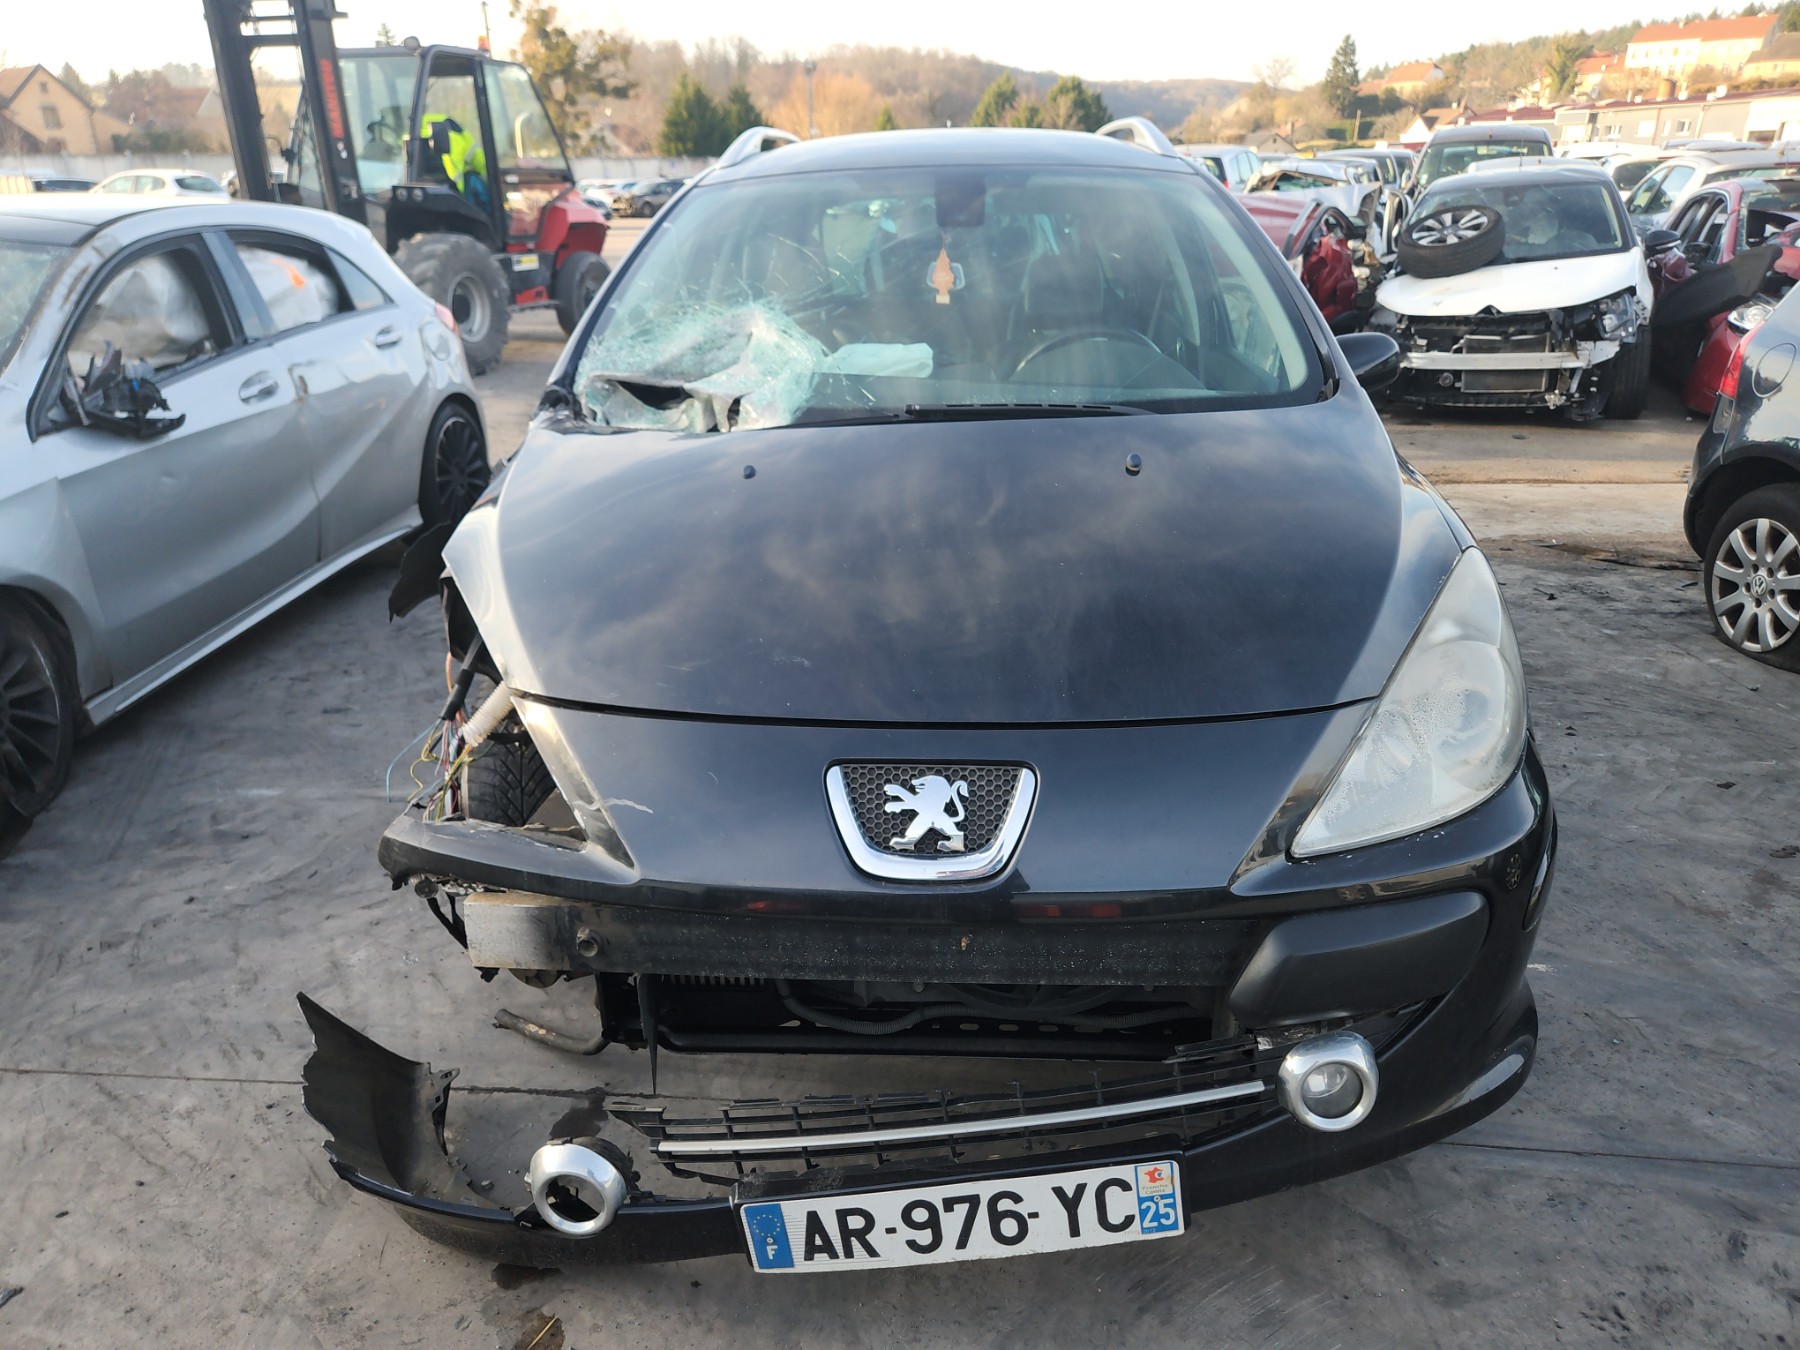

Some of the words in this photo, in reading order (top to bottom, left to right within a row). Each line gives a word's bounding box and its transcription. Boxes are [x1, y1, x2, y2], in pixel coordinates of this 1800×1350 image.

[804, 1178, 1135, 1261] AR-976-YC
[1141, 1198, 1175, 1228] 25
[766, 1245, 778, 1260] F
